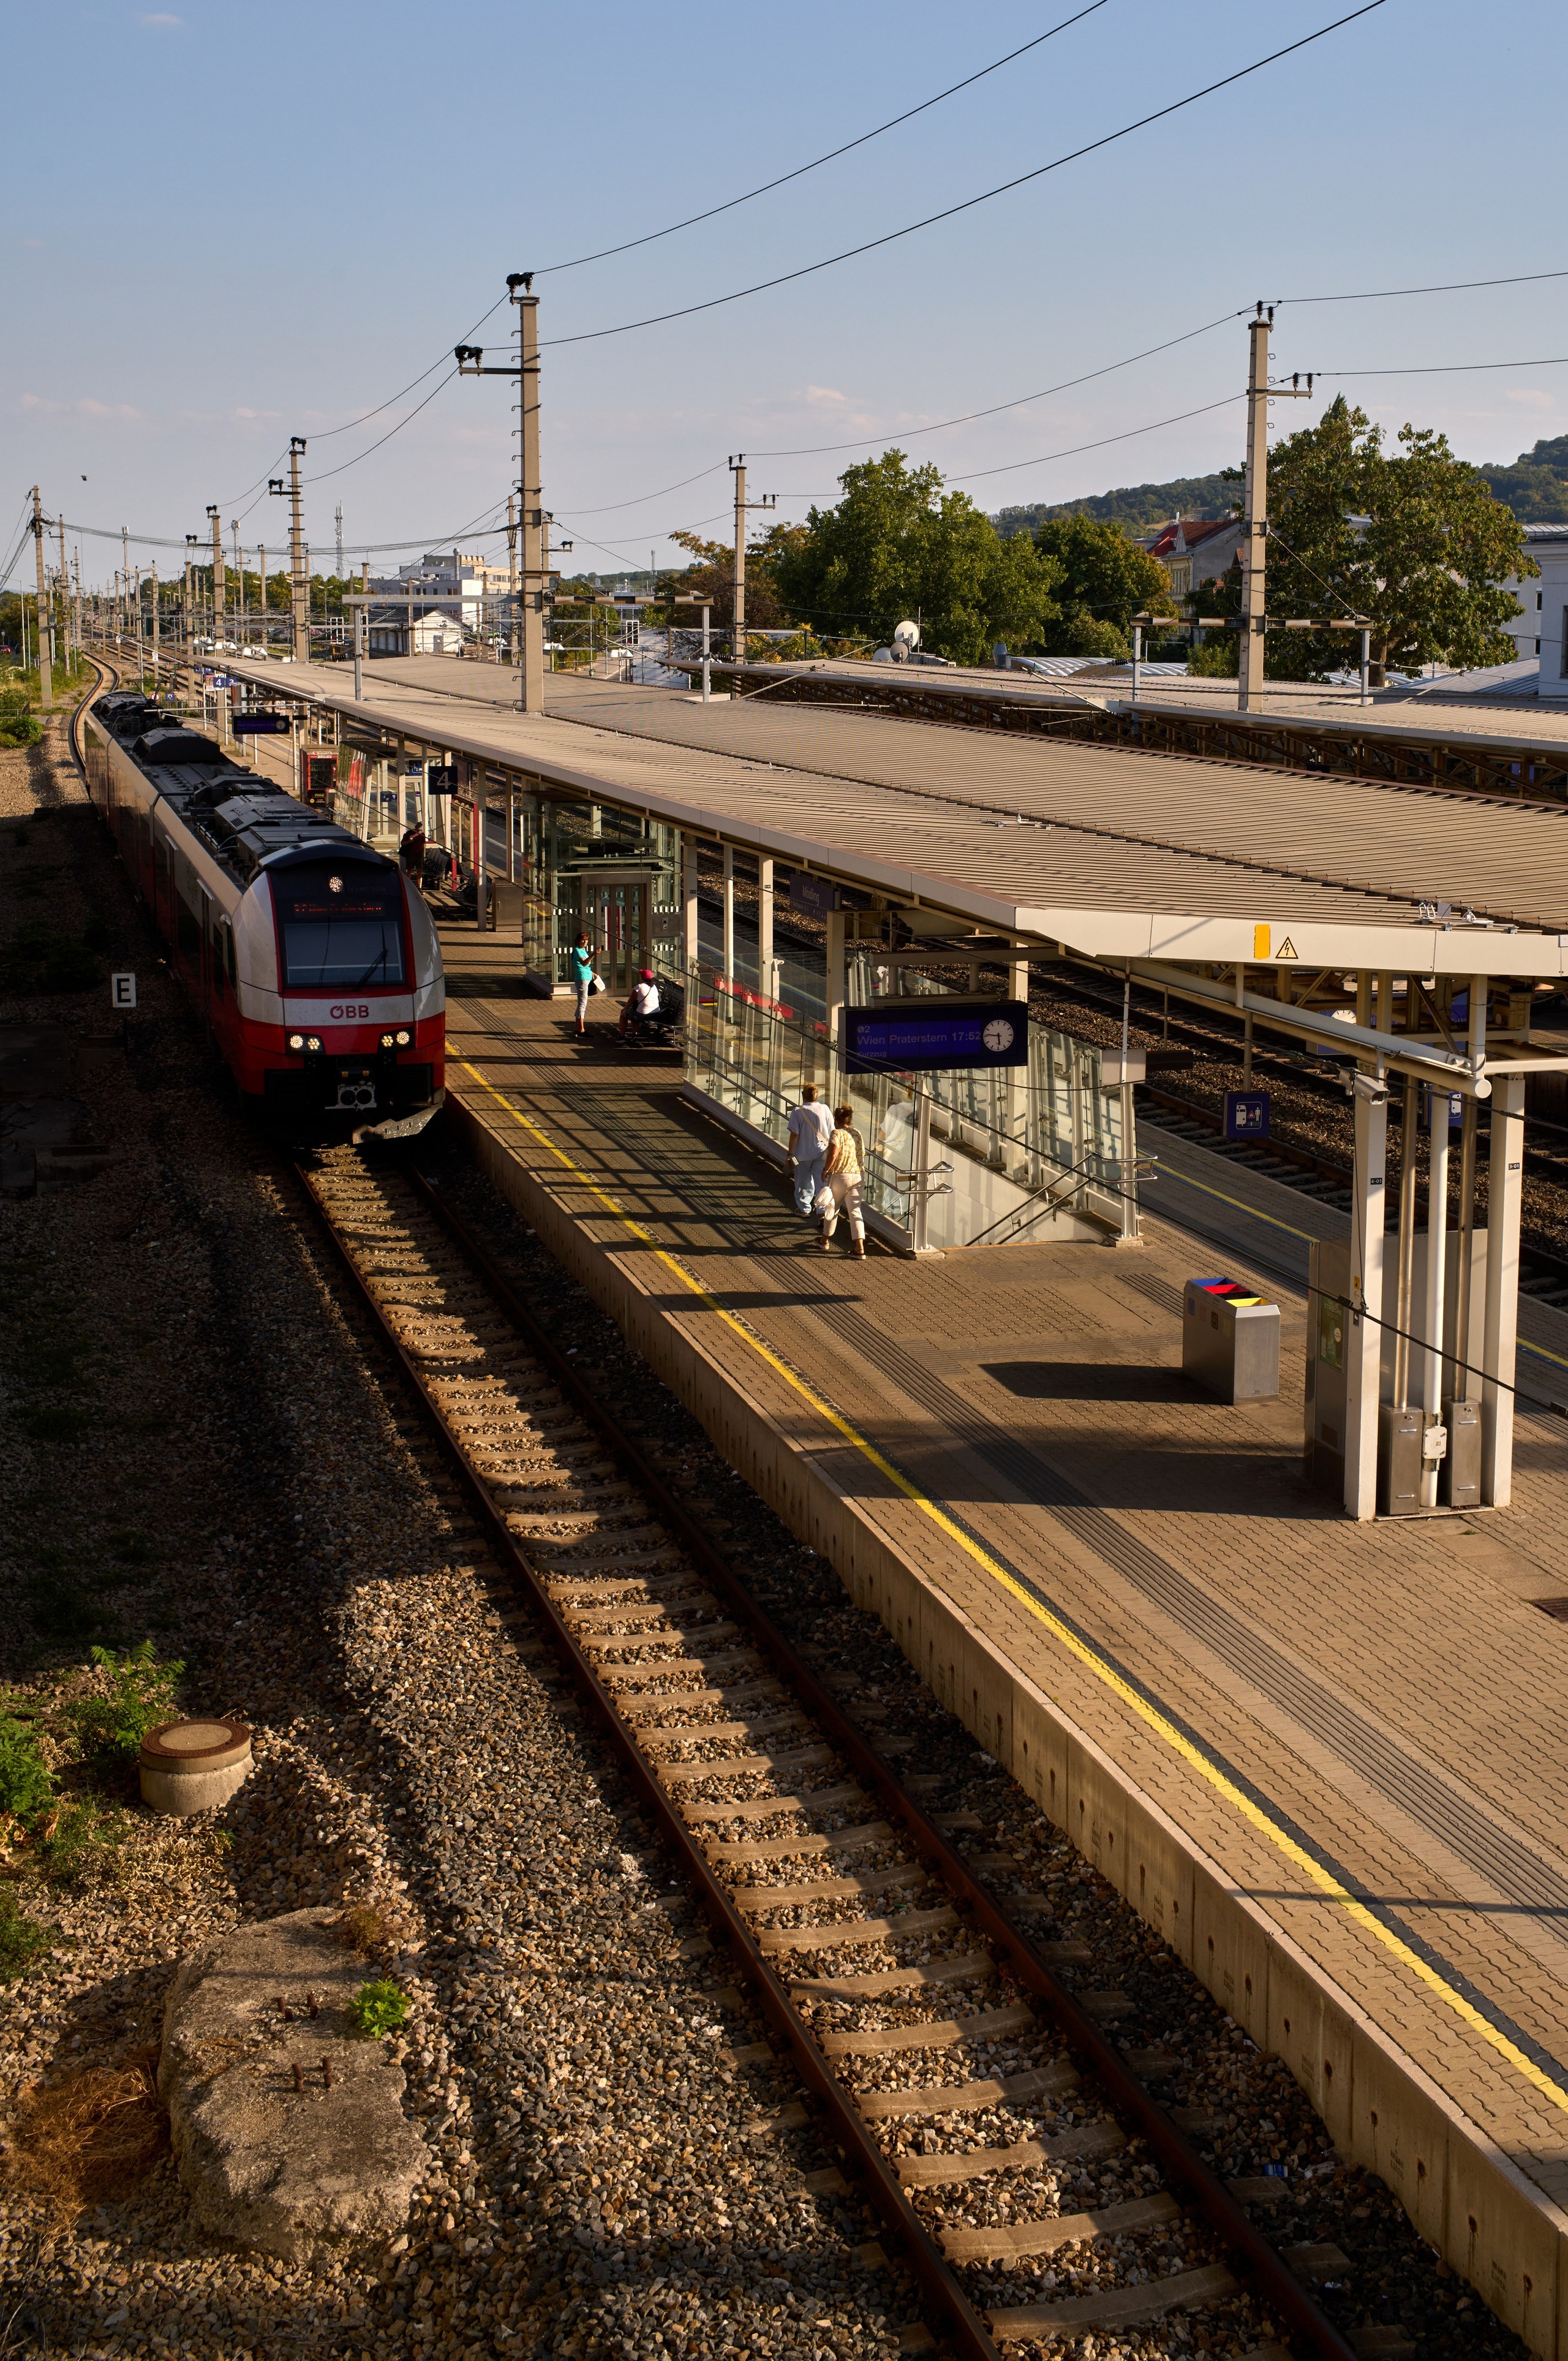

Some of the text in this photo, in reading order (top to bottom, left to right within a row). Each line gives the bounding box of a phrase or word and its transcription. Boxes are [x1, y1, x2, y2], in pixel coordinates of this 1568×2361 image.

[436, 772, 451, 789] 4
[802, 886, 820, 906] Mödling
[116, 978, 131, 1003] E
[330, 1005, 369, 1019] ÖBB
[858, 1031, 981, 1045] Wien Praterstern 17:52
[858, 1050, 887, 1059] Kurzzug
